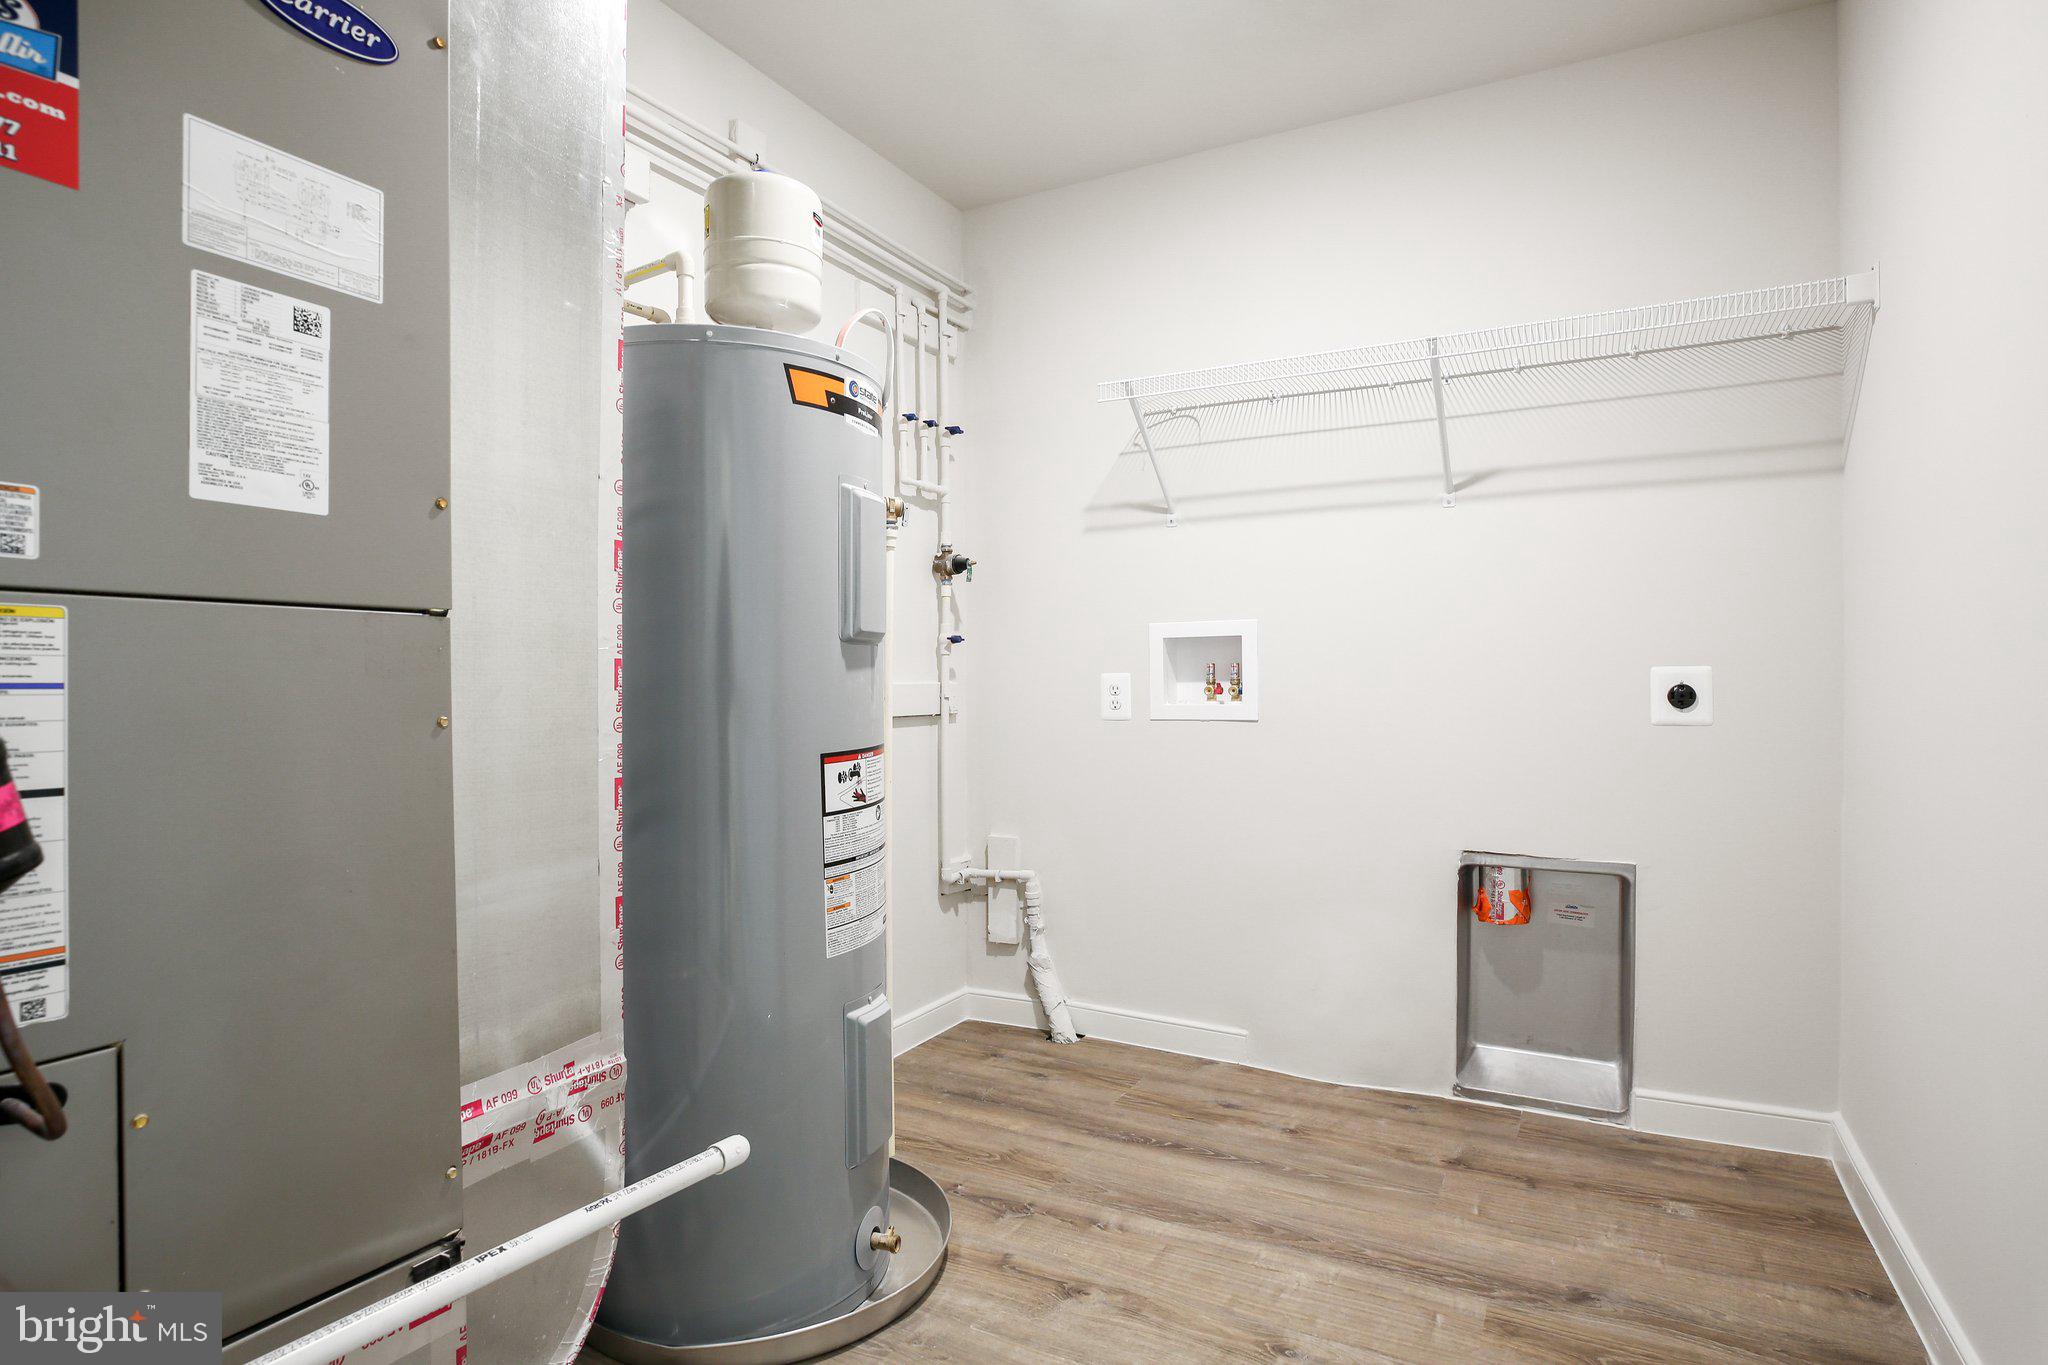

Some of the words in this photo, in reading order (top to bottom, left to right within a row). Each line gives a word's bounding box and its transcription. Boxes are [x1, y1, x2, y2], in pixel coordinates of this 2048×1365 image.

[486, 1096, 498, 1110] AF
[501, 1089, 518, 1104] 099
[600, 1096, 615, 1109] 099
[493, 1130, 509, 1142] AF
[509, 1121, 527, 1136] 099
[474, 1245, 507, 1264] IPEX
